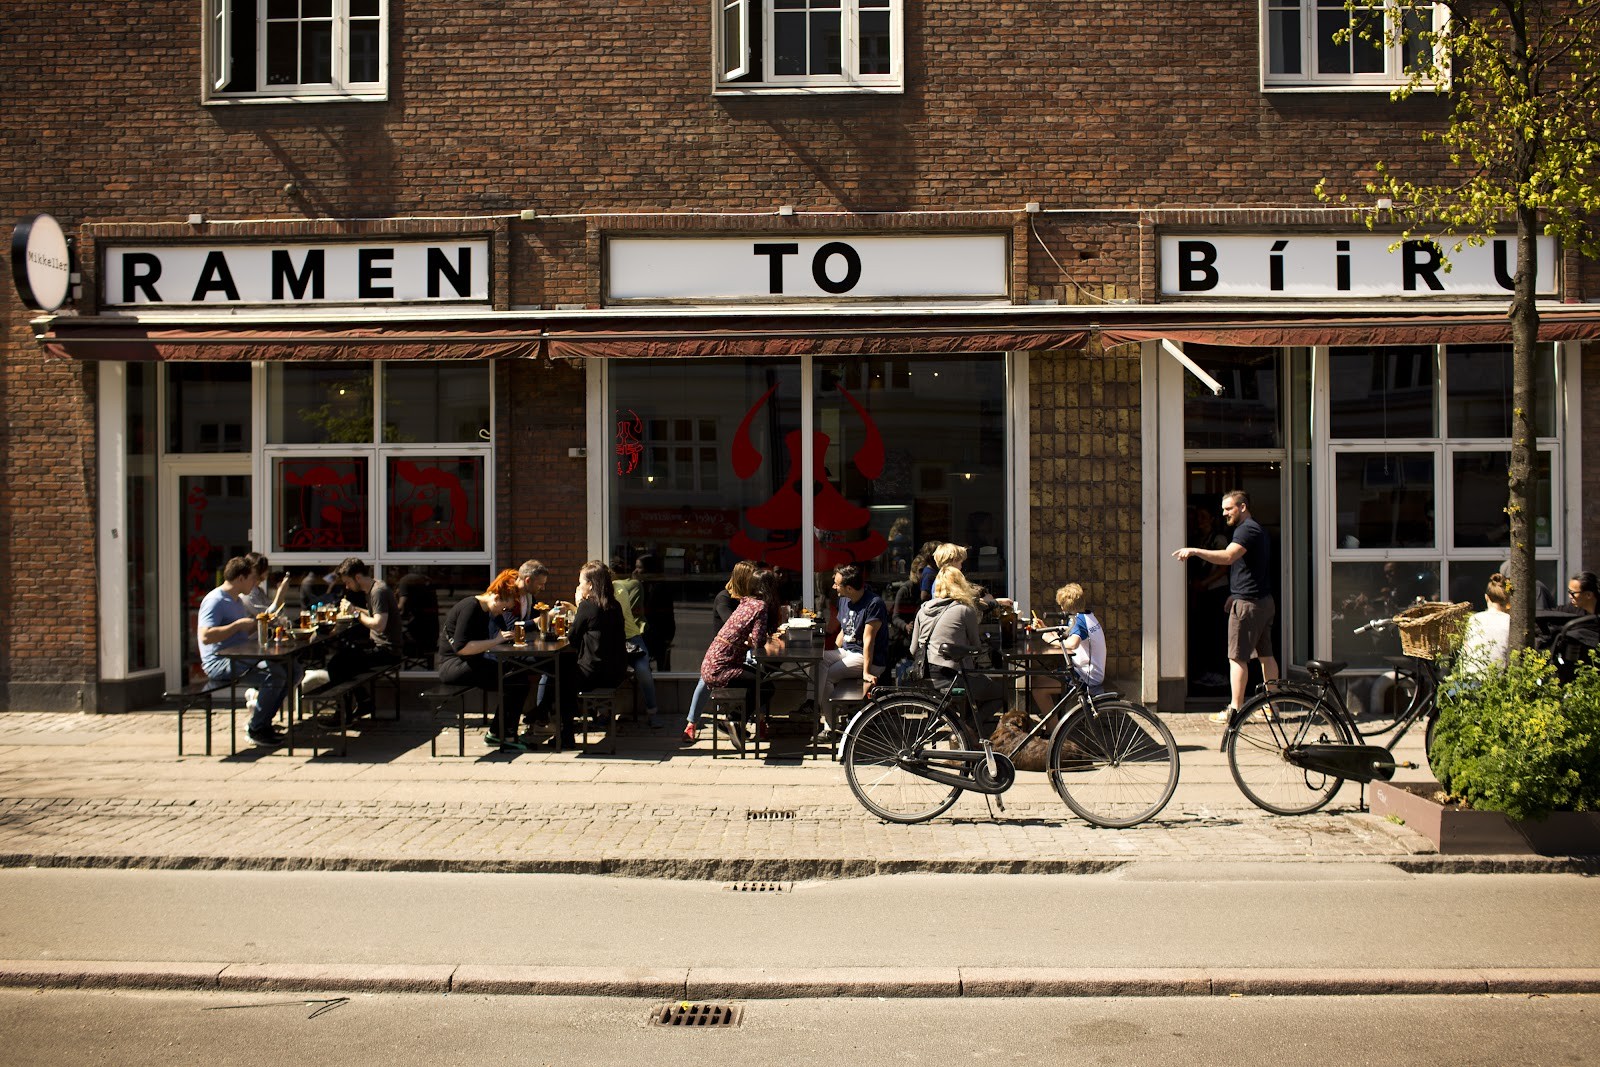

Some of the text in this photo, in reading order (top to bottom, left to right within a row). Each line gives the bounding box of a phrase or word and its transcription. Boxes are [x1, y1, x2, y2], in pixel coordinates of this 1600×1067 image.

[28, 250, 68, 272] Mikkeller
[122, 247, 472, 302] RAMEN
[753, 241, 862, 294] TO
